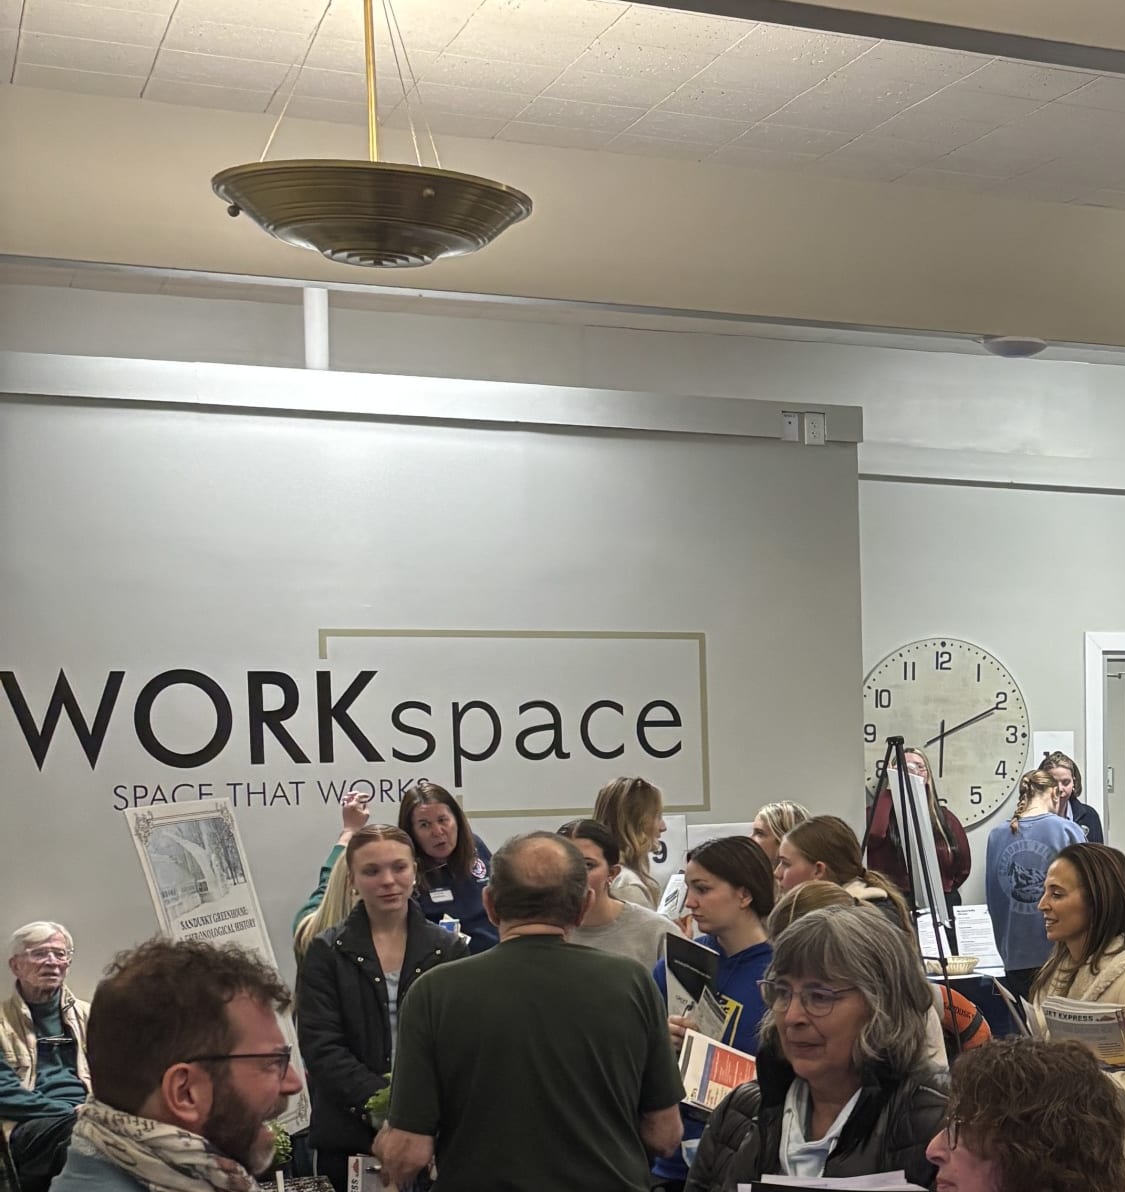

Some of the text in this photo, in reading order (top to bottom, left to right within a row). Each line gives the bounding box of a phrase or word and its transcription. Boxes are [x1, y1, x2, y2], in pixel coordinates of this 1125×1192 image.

[935, 651, 952, 670] 12
[903, 661, 916, 681] 11
[875, 689, 891, 709] 10
[995, 691, 1008, 711] 2
[0, 667, 683, 788] WORKspace
[863, 723, 877, 743] 9
[1005, 725, 1018, 744] 3
[994, 761, 1007, 779] 4
[226, 781, 305, 807] THAT
[970, 786, 982, 804] 5
[213, 906, 249, 923] GREENHOUSE
[1058, 1013, 1094, 1022] EXPRESS
